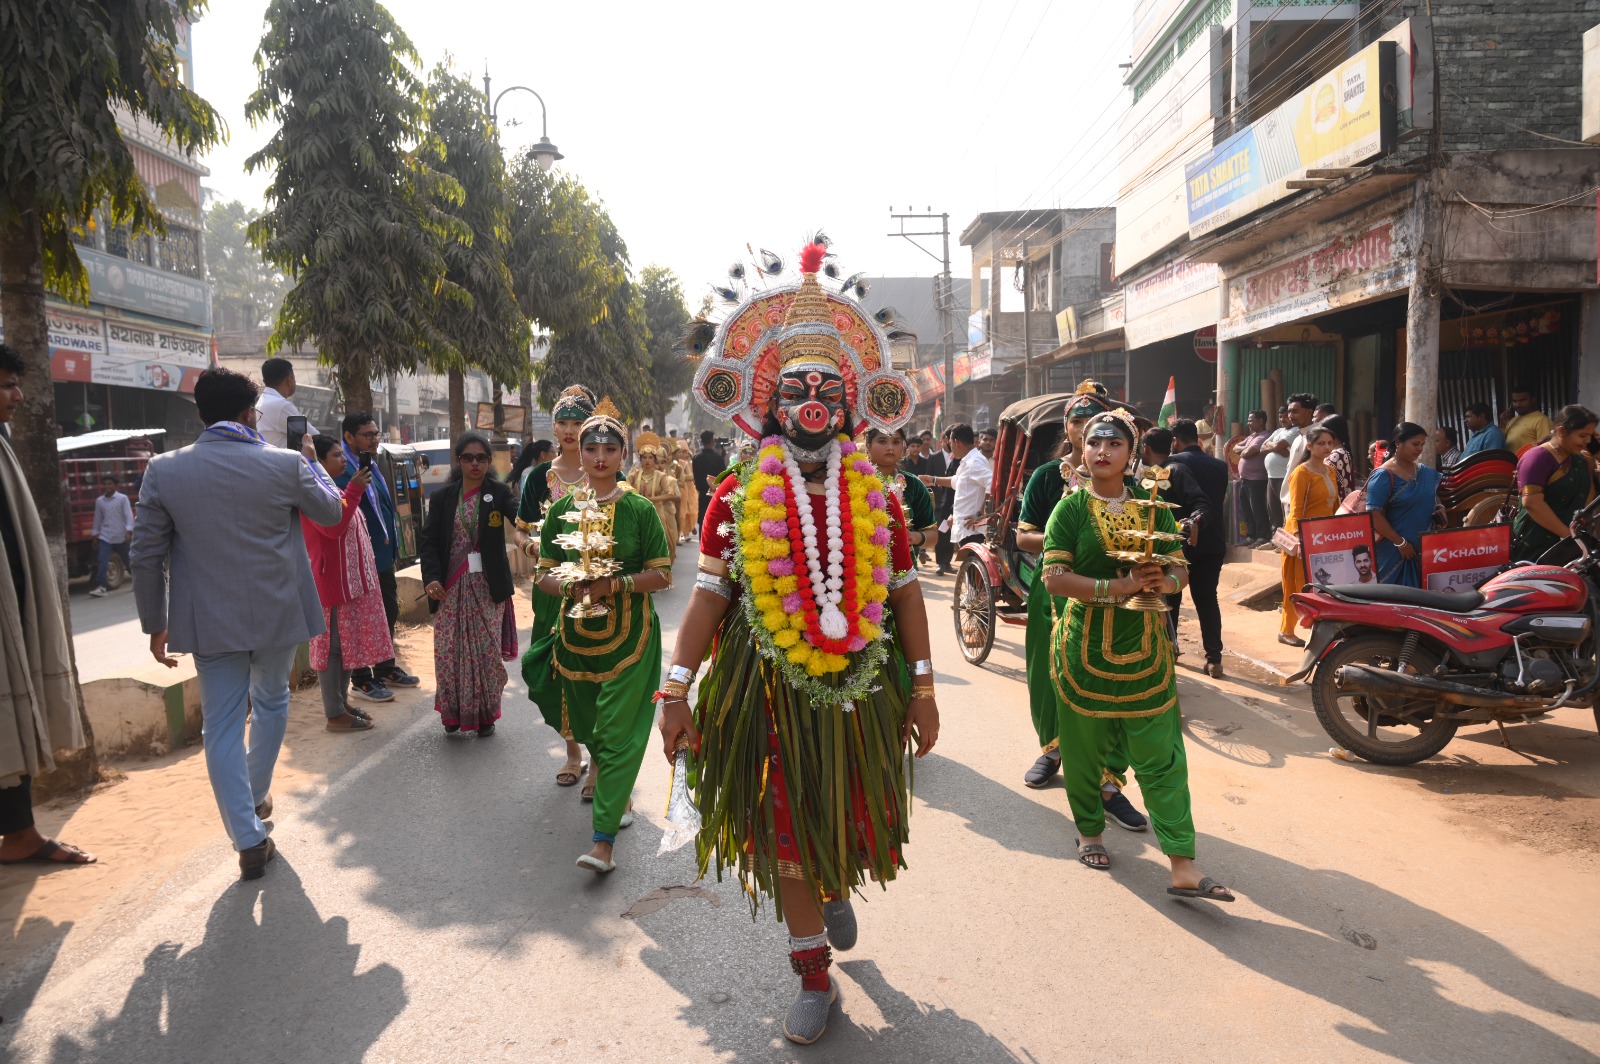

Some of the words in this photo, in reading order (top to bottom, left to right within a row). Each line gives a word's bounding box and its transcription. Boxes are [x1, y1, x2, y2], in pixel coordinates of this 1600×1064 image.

[1346, 73, 1362, 87] TATA
[1343, 81, 1365, 103] SHAKTEE
[1190, 173, 1210, 201] TATA
[1210, 147, 1250, 190] SHAKTEE
[47, 335, 102, 351] ARDWARE
[1194, 338, 1218, 348] Hawk
[1324, 530, 1364, 542] KHADIM
[1449, 545, 1499, 559] KHADIM
[1314, 553, 1345, 566] FLIERS
[1448, 571, 1486, 586] FLIERS
